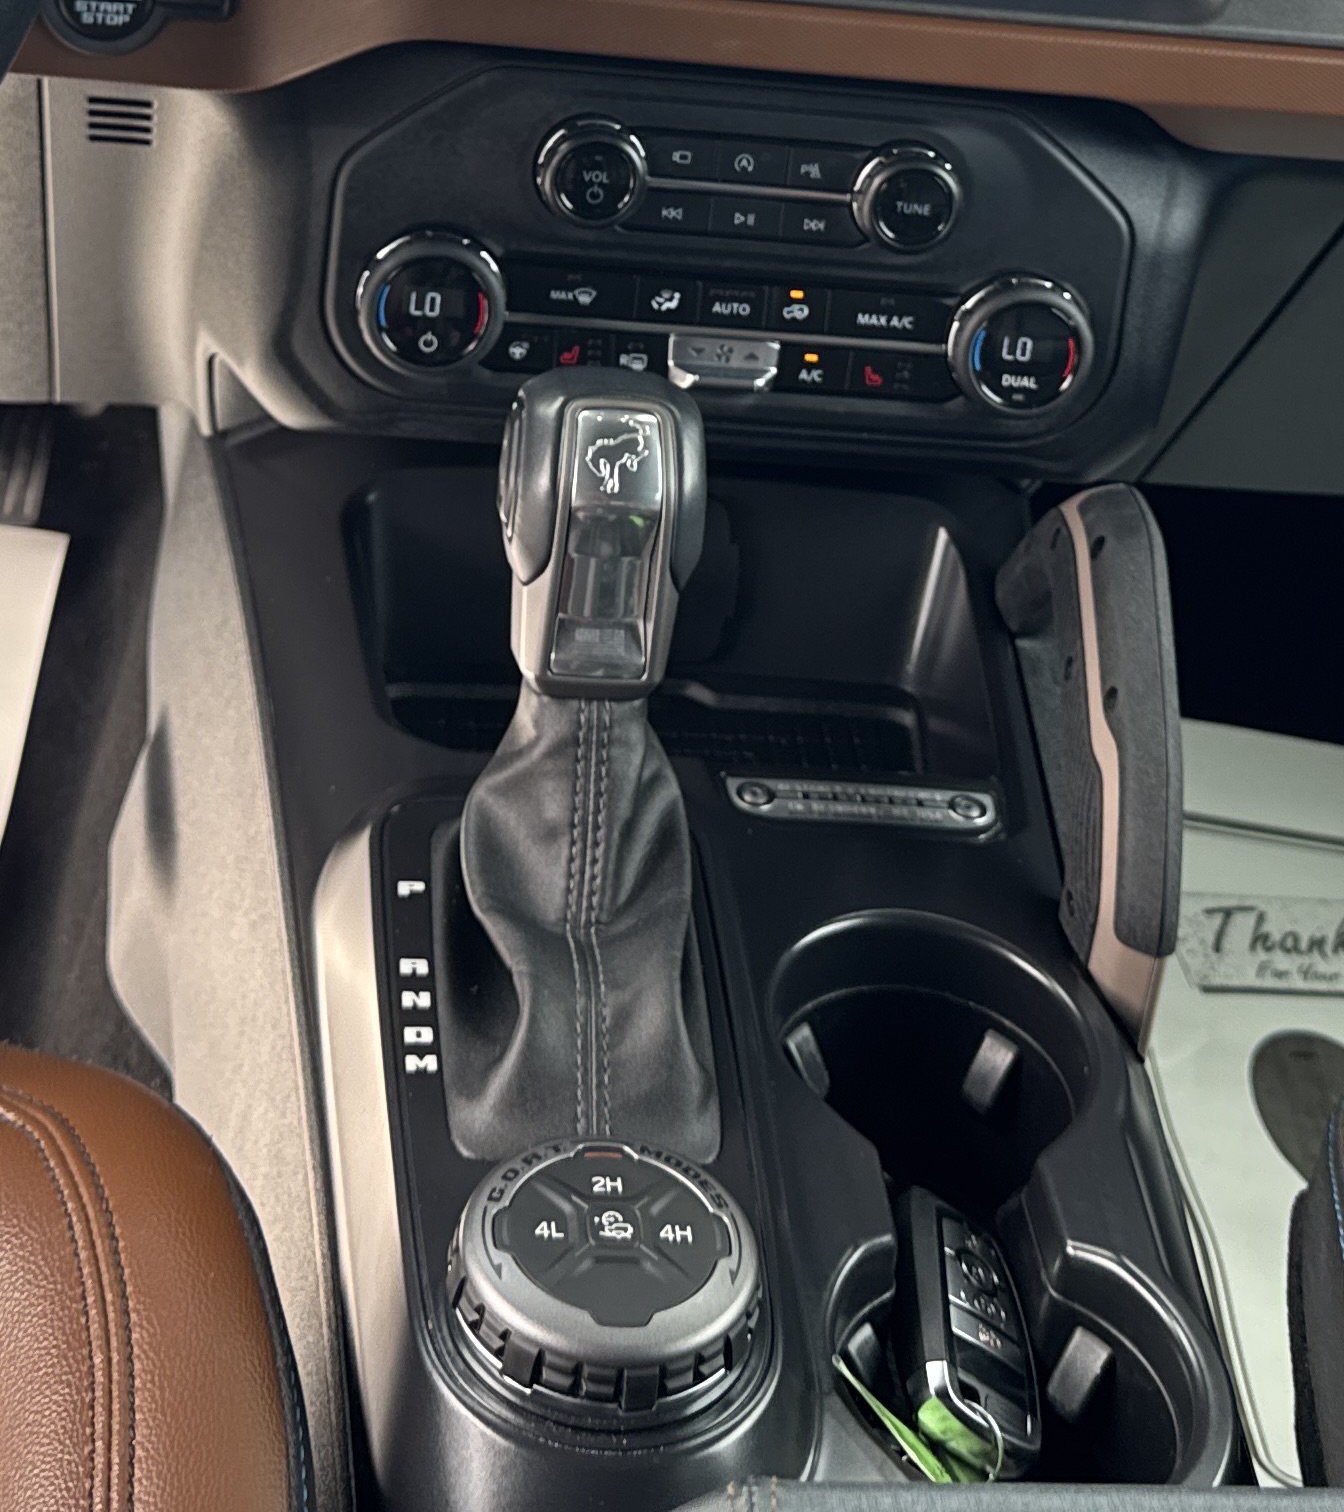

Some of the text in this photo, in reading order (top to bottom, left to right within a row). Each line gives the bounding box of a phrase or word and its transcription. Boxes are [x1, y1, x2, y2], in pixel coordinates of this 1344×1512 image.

[74, 0, 136, 14] START
[80, 11, 130, 26] STOP
[582, 170, 610, 184] VOL
[895, 201, 931, 217] TUNE
[549, 289, 575, 302] MAX
[409, 291, 442, 318] LO
[712, 300, 752, 317] AUTO
[856, 312, 915, 330] MAX A/C
[1001, 336, 1034, 362] LO
[798, 368, 824, 383] A/C
[1001, 373, 1038, 390] DUAL
[397, 881, 426, 898] P
[401, 990, 431, 1009] N
[405, 1054, 438, 1074] M
[591, 1176, 623, 1194] 2H
[640, 1145, 729, 1210] MODES
[534, 1220, 565, 1239] 4L
[659, 1224, 693, 1243] 4H
